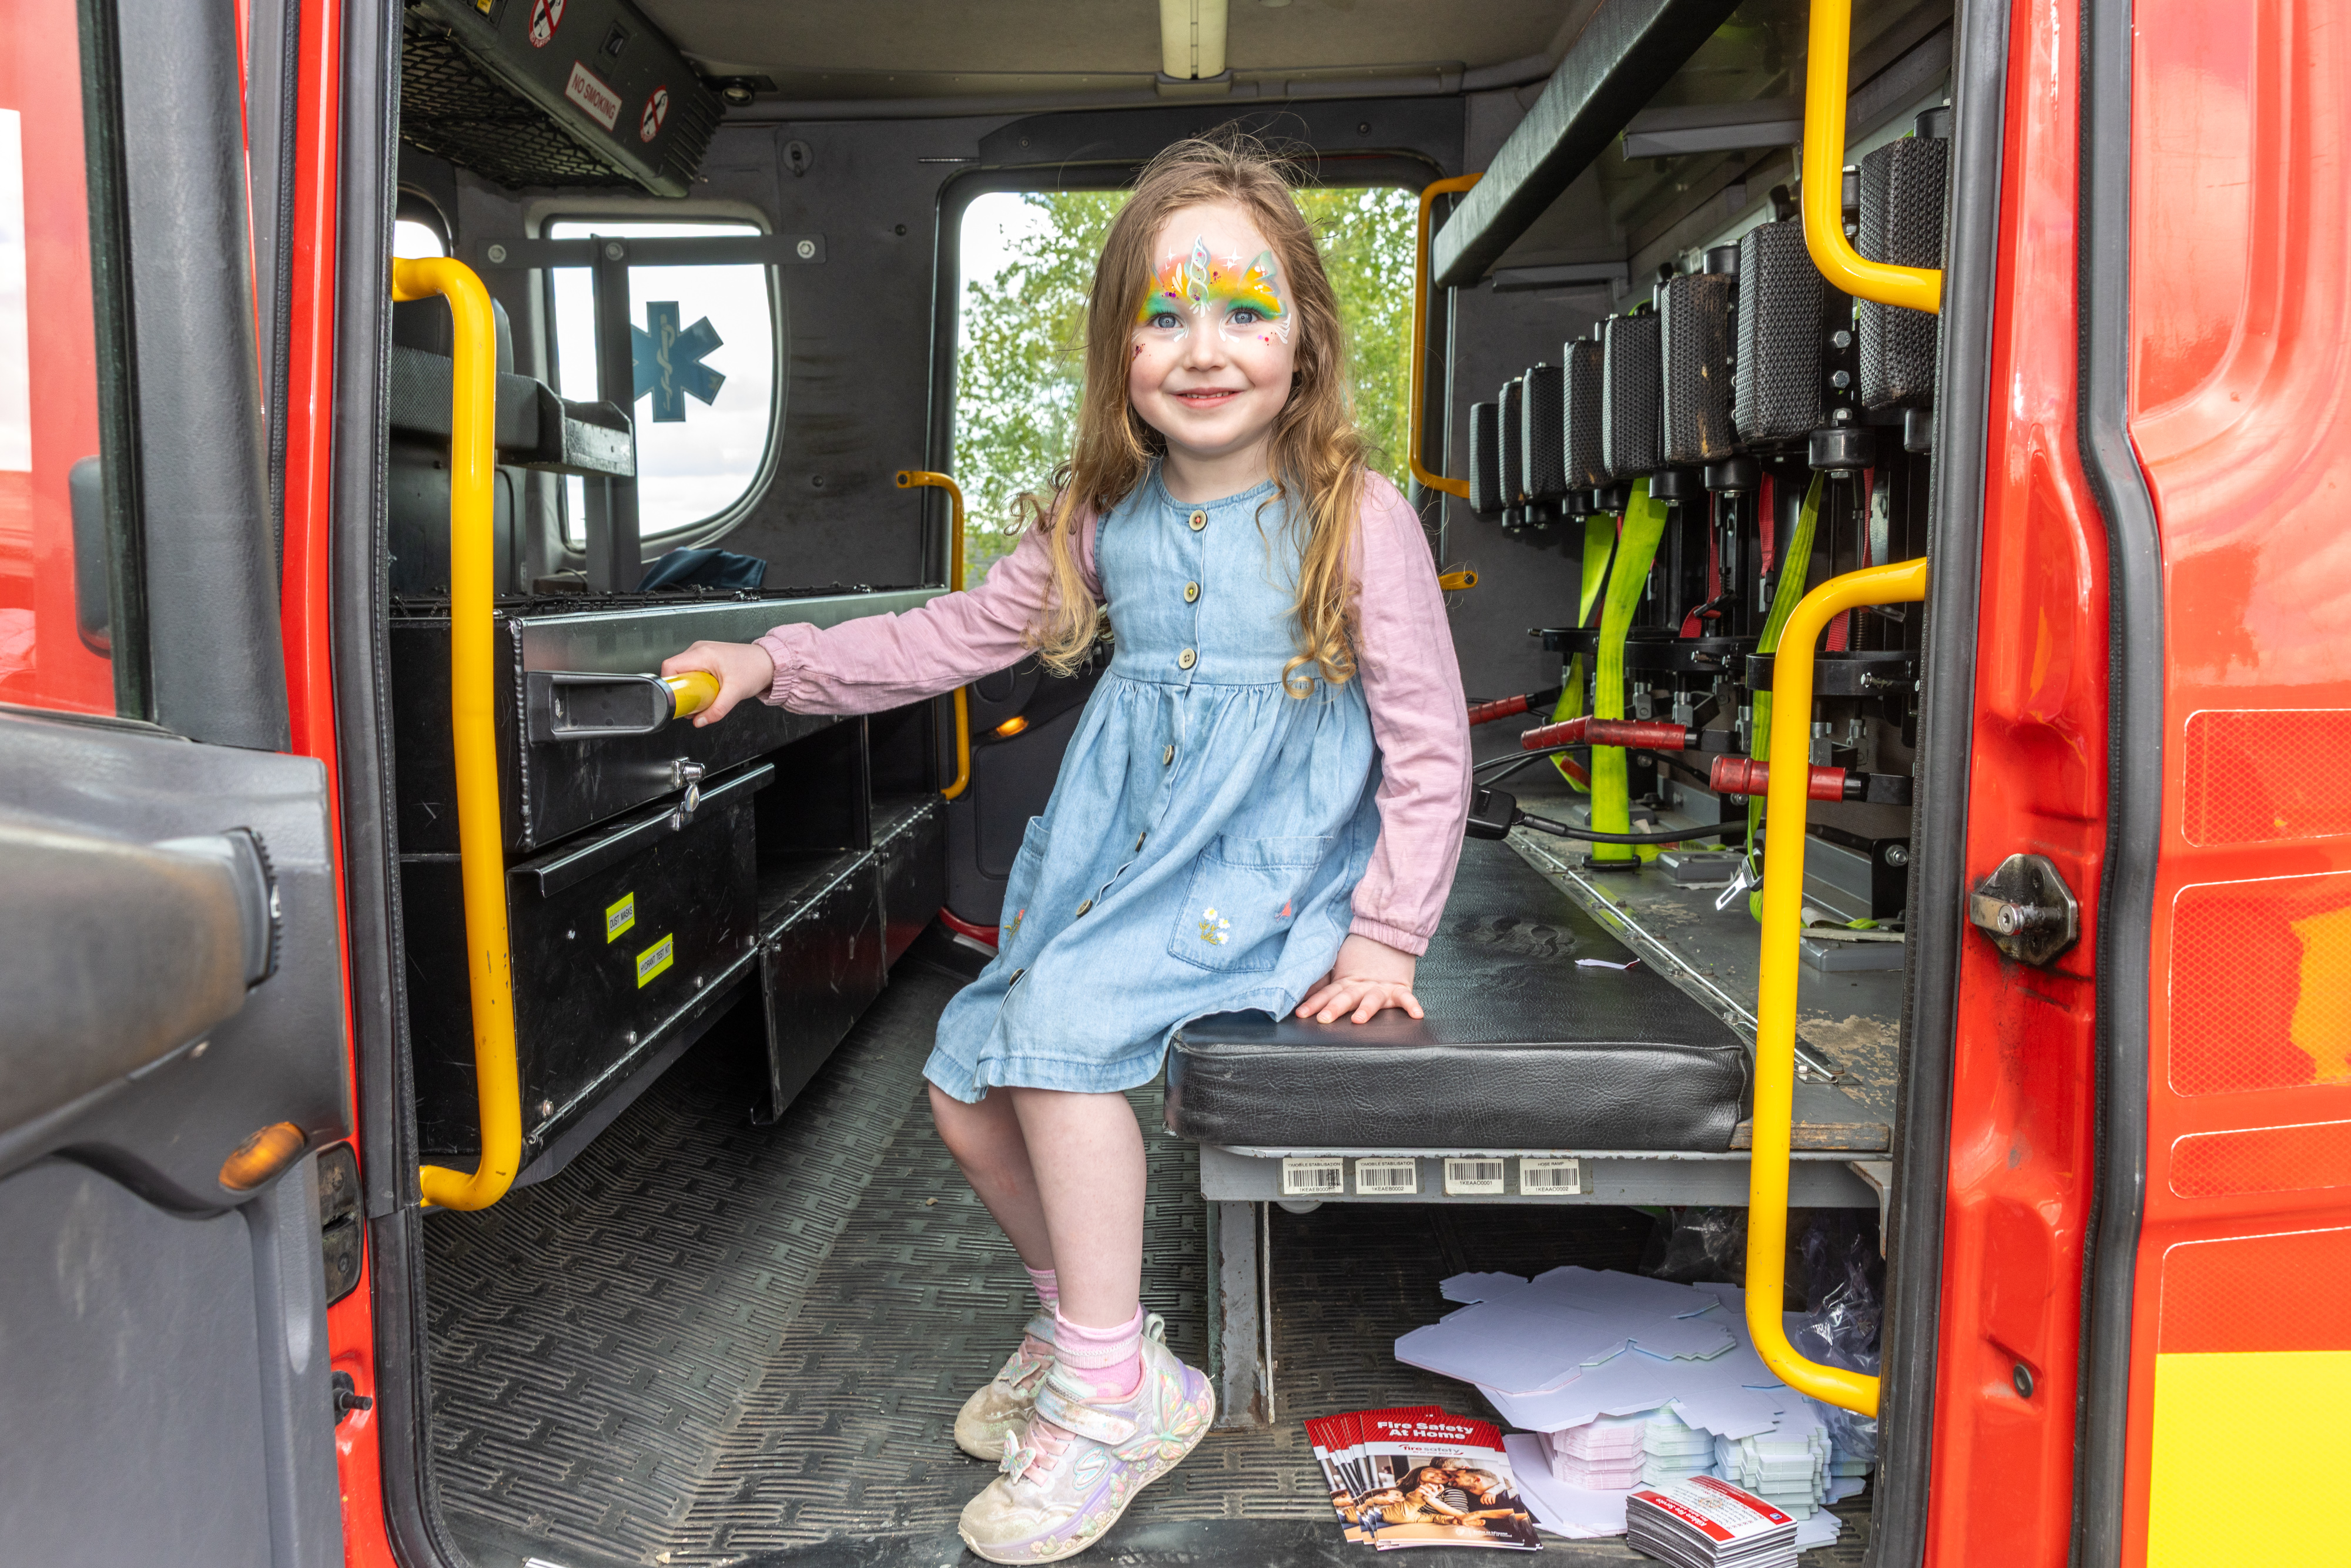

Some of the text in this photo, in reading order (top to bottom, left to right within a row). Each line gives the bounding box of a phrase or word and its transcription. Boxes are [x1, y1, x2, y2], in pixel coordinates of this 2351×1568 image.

[572, 73, 616, 120] NO SMOKING
[609, 906, 633, 929] DUST MASKS
[640, 956, 655, 974] HYDRANT
[656, 949, 665, 960] TEST
[1377, 1421, 1473, 1435] Fire Safety
[1413, 1429, 1465, 1439] Home
